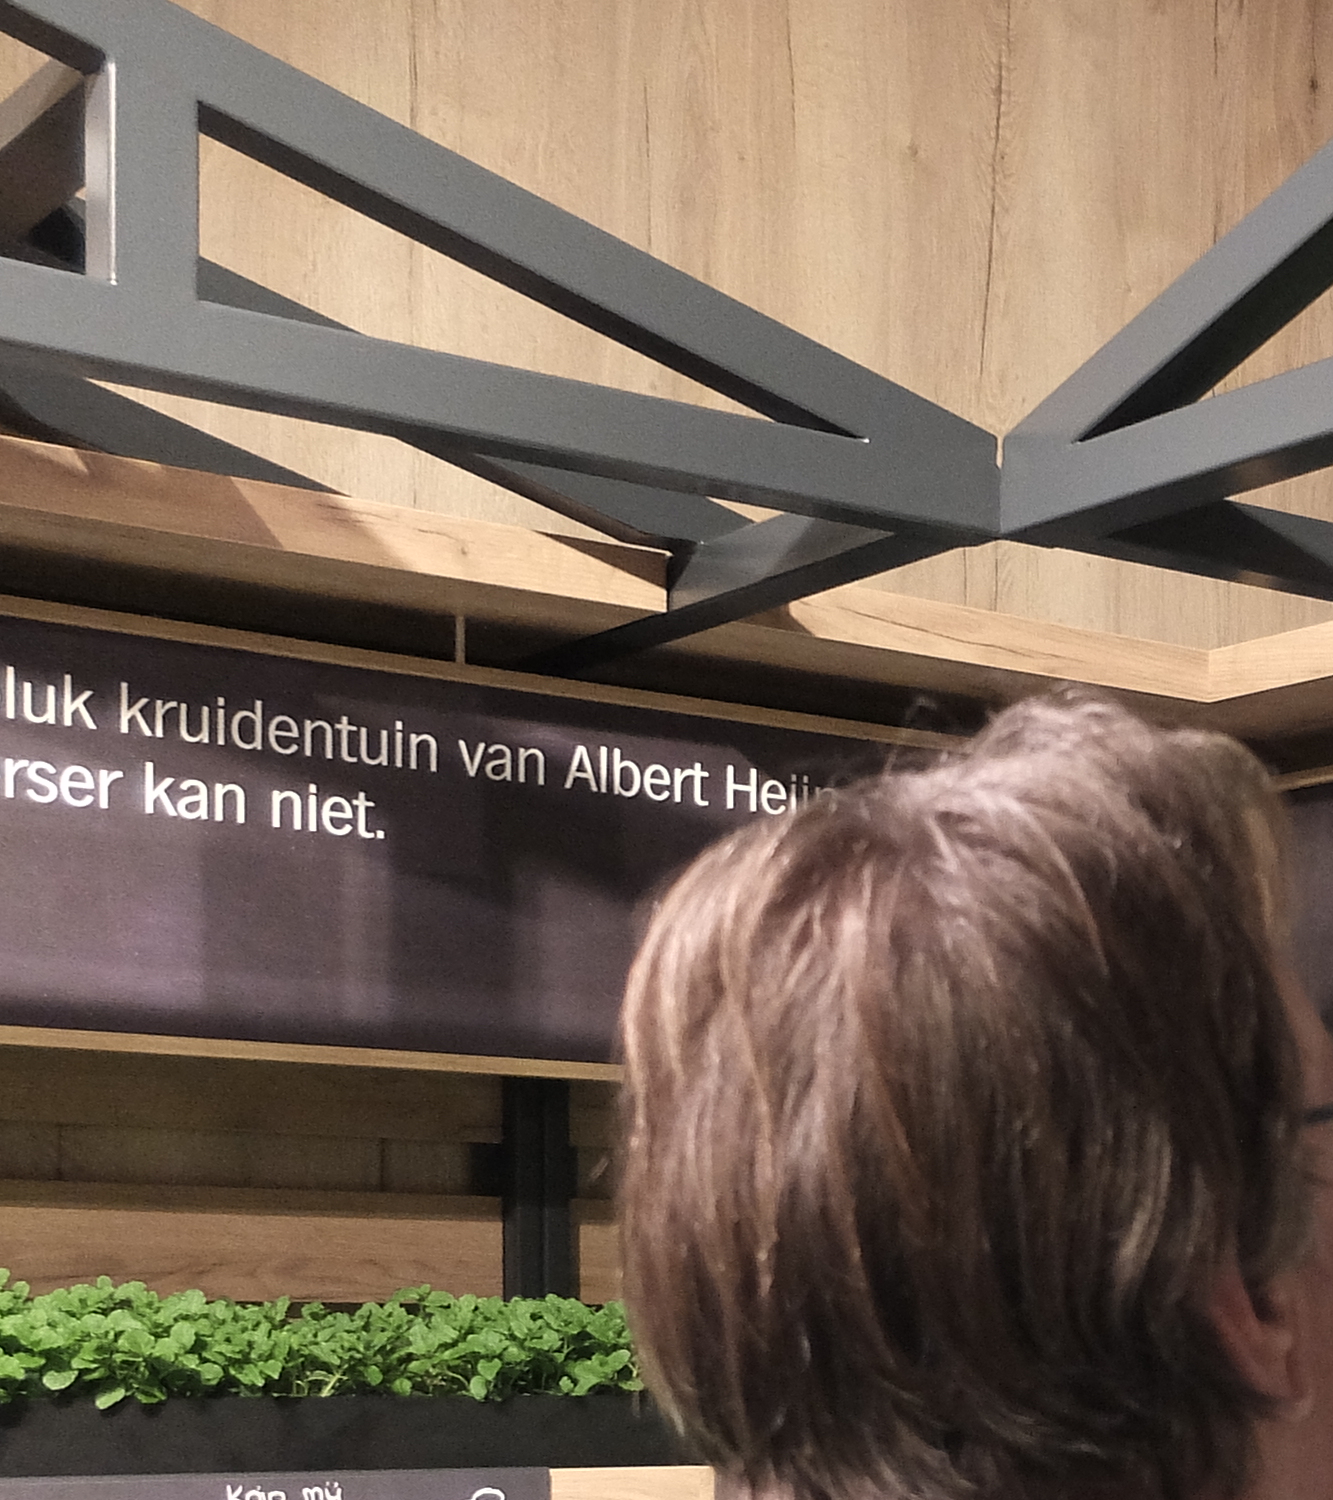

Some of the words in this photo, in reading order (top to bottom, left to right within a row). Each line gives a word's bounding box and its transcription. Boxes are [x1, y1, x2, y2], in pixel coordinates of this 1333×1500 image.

[5, 665, 97, 730] luk
[120, 681, 438, 772] kruidentuin
[458, 740, 546, 786] van
[564, 745, 709, 807] Albert
[4, 758, 124, 809] rser
[144, 762, 246, 824] kan
[271, 783, 385, 839] niet.
